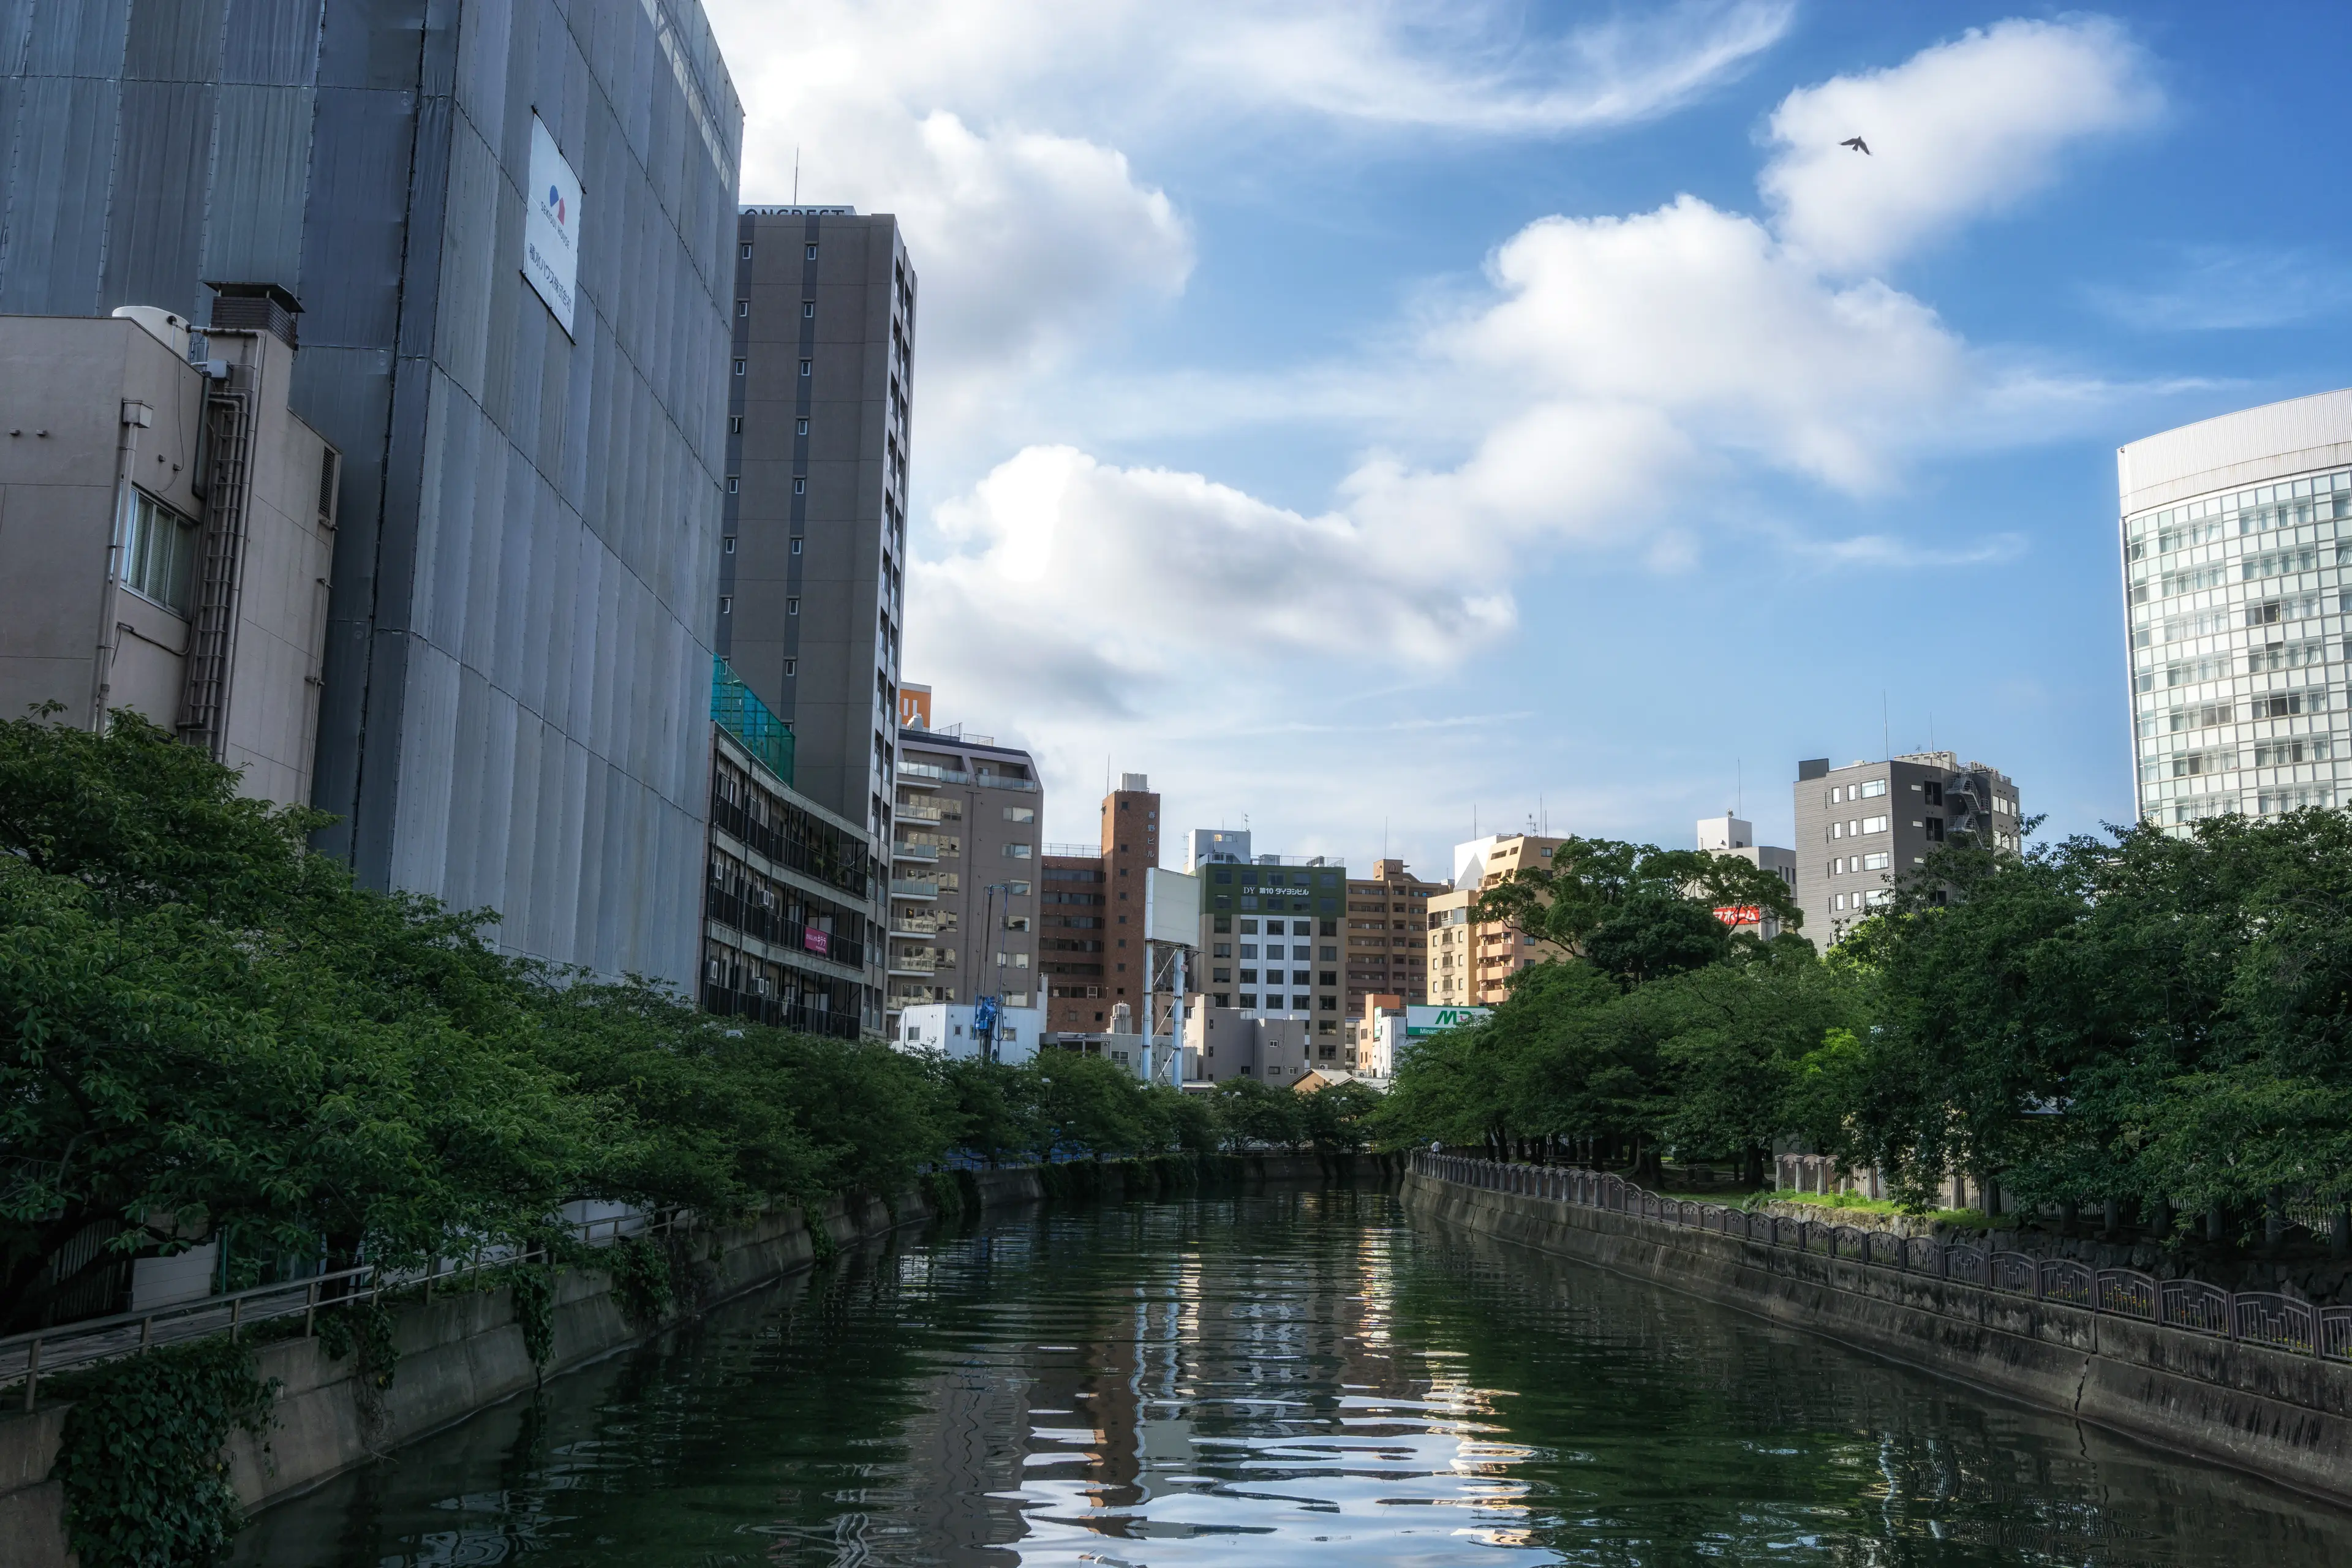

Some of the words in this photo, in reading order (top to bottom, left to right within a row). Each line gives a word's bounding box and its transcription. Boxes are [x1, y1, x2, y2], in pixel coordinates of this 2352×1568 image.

[541, 201, 557, 230] SEKISUI
[557, 225, 570, 250] HOUSE
[529, 243, 571, 313] 積水ハウス株式会社
